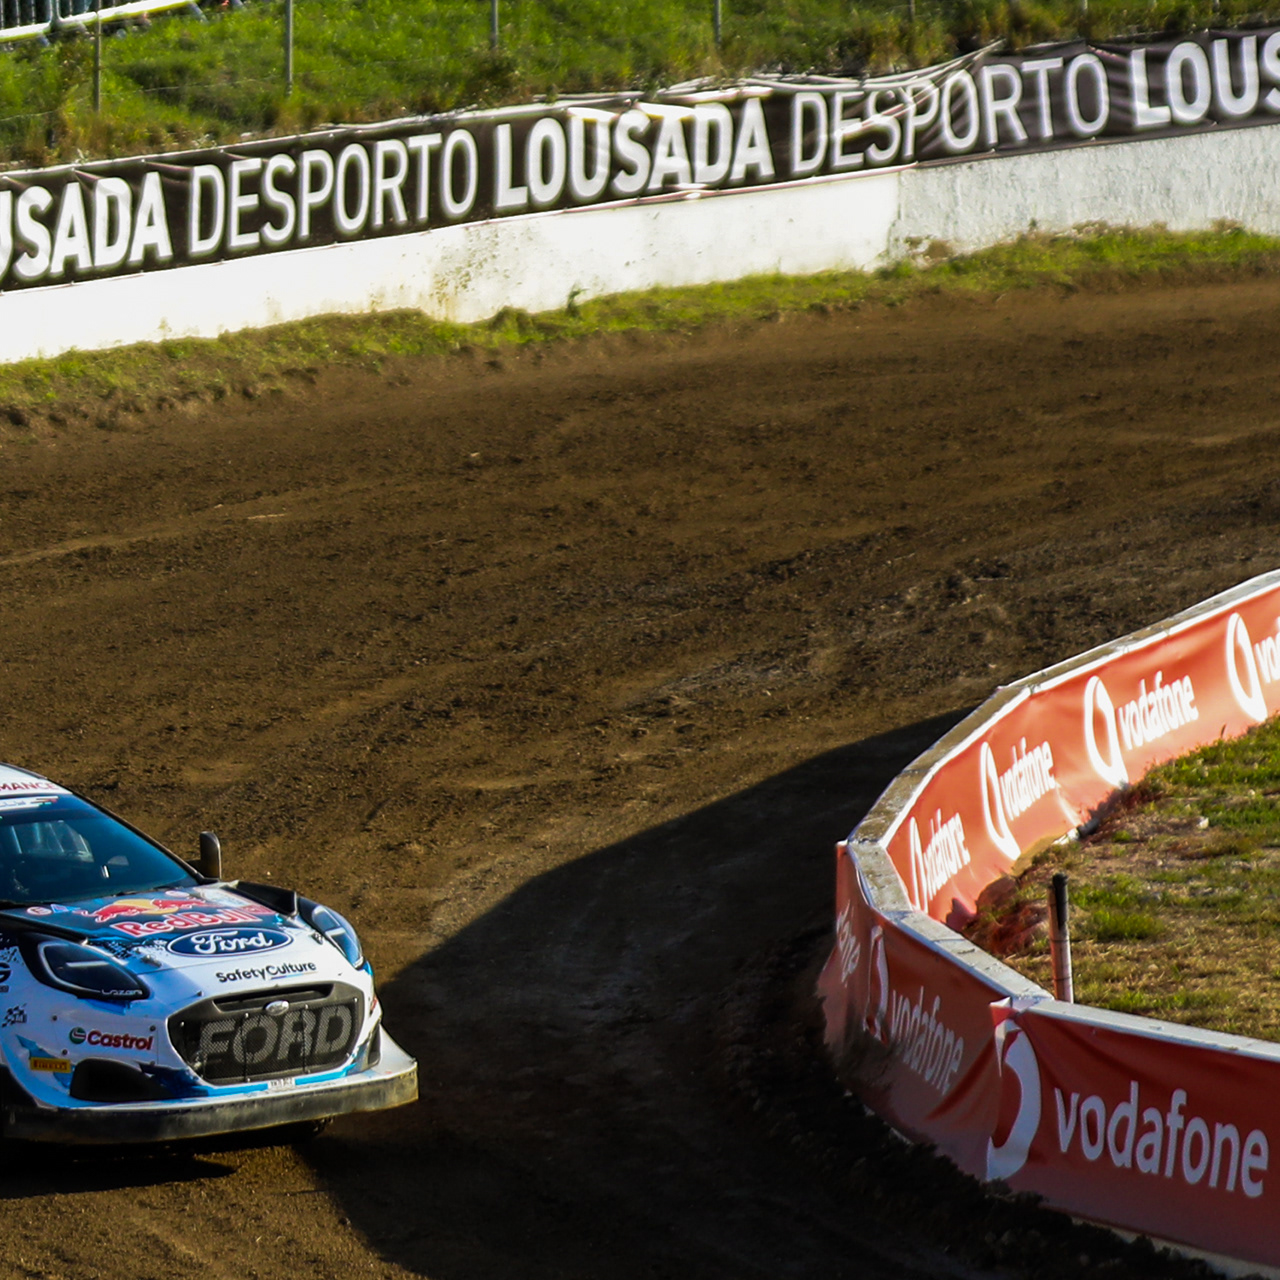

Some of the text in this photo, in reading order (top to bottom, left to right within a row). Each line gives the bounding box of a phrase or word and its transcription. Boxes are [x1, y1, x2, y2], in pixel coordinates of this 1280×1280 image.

[189, 128, 478, 256] DESPORTO
[493, 97, 775, 210] LOUSADA
[791, 52, 1109, 177] DESPORTO
[1118, 671, 1199, 751] vodafone
[999, 737, 1056, 820] vodafone
[924, 808, 971, 901] vodafone
[192, 930, 274, 956] Ford
[87, 1030, 154, 1051] Castrol
[199, 1005, 353, 1064] FORD
[891, 985, 965, 1096] vodafone
[1054, 1080, 1269, 1198] vodafone
